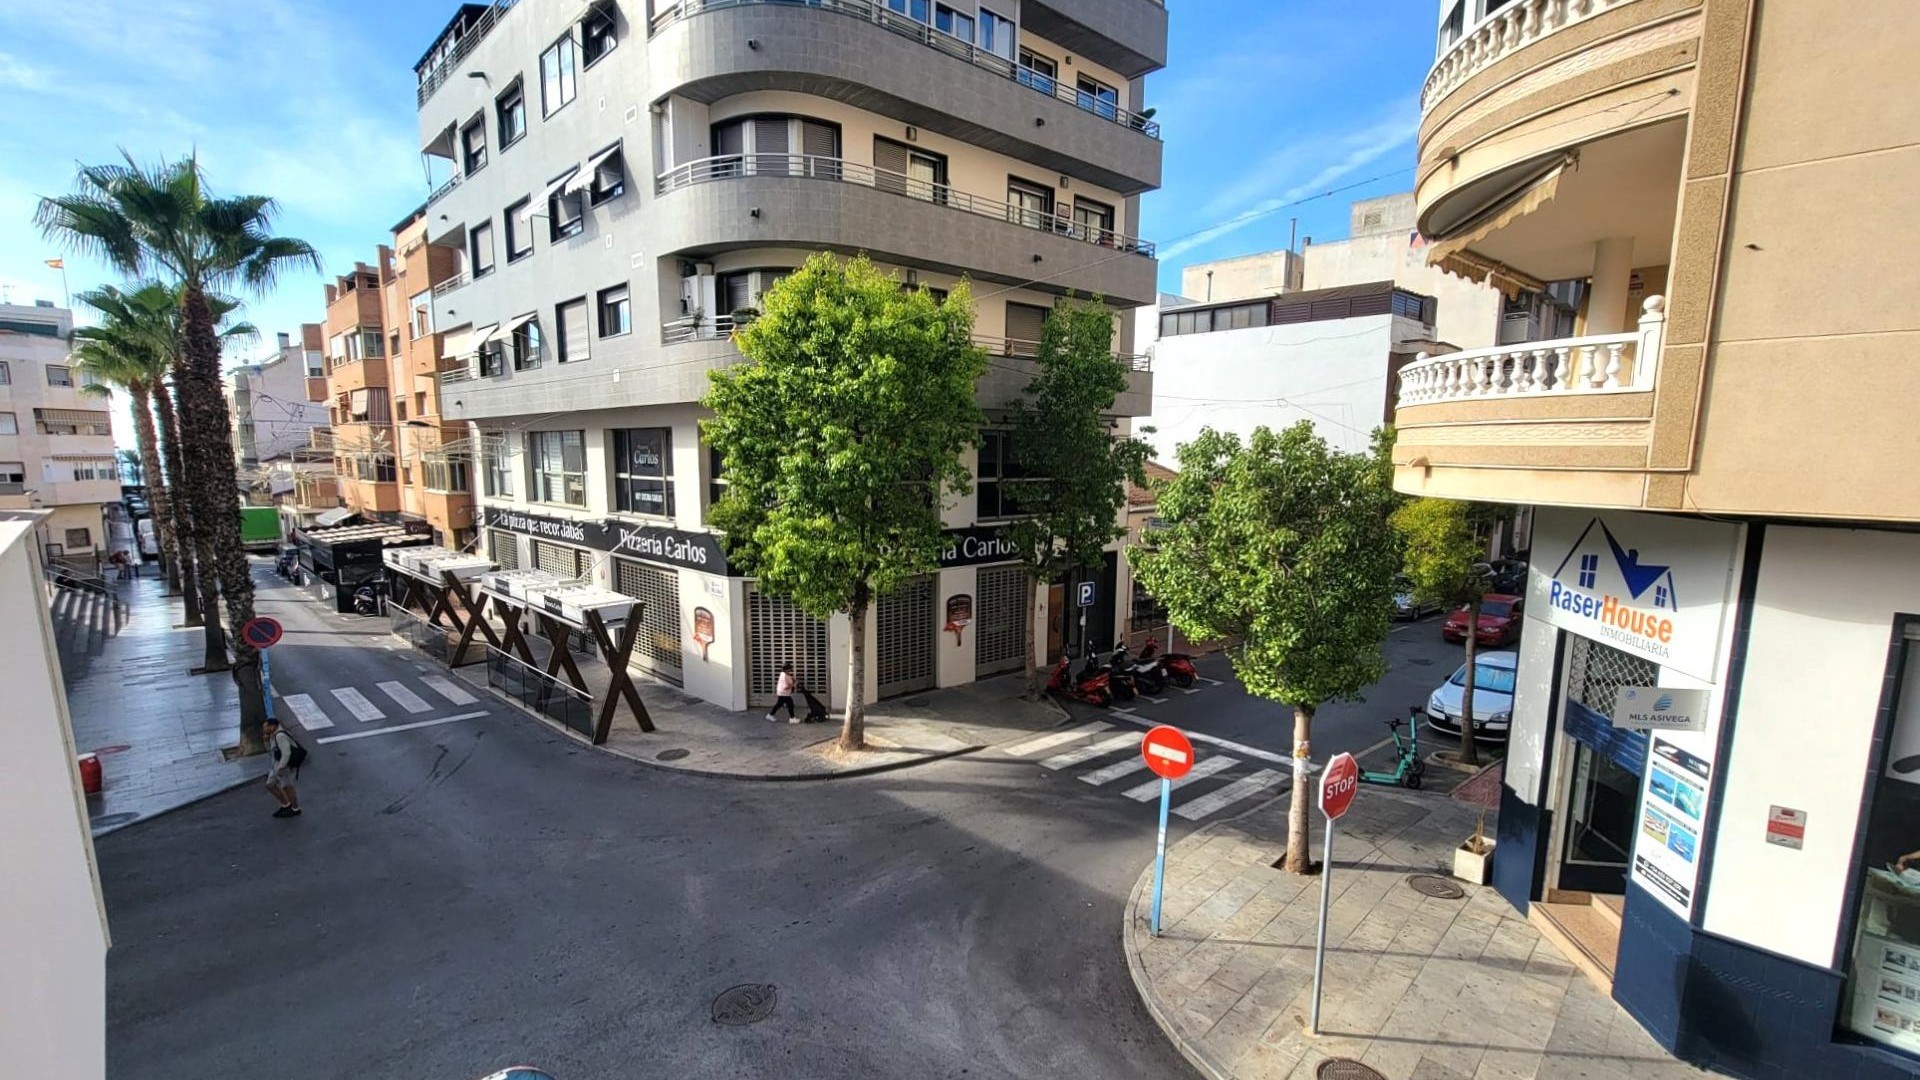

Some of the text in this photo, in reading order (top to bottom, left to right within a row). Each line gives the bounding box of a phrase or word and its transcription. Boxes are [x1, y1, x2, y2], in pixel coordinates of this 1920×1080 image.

[509, 512, 526, 532] pizza
[665, 536, 706, 564] Carlos
[1081, 585, 1092, 604] P
[1600, 625, 1669, 659] INMOBILIARIA
[1629, 713, 1691, 723] MLS ASIVEGA
[1326, 775, 1354, 799] STOP
